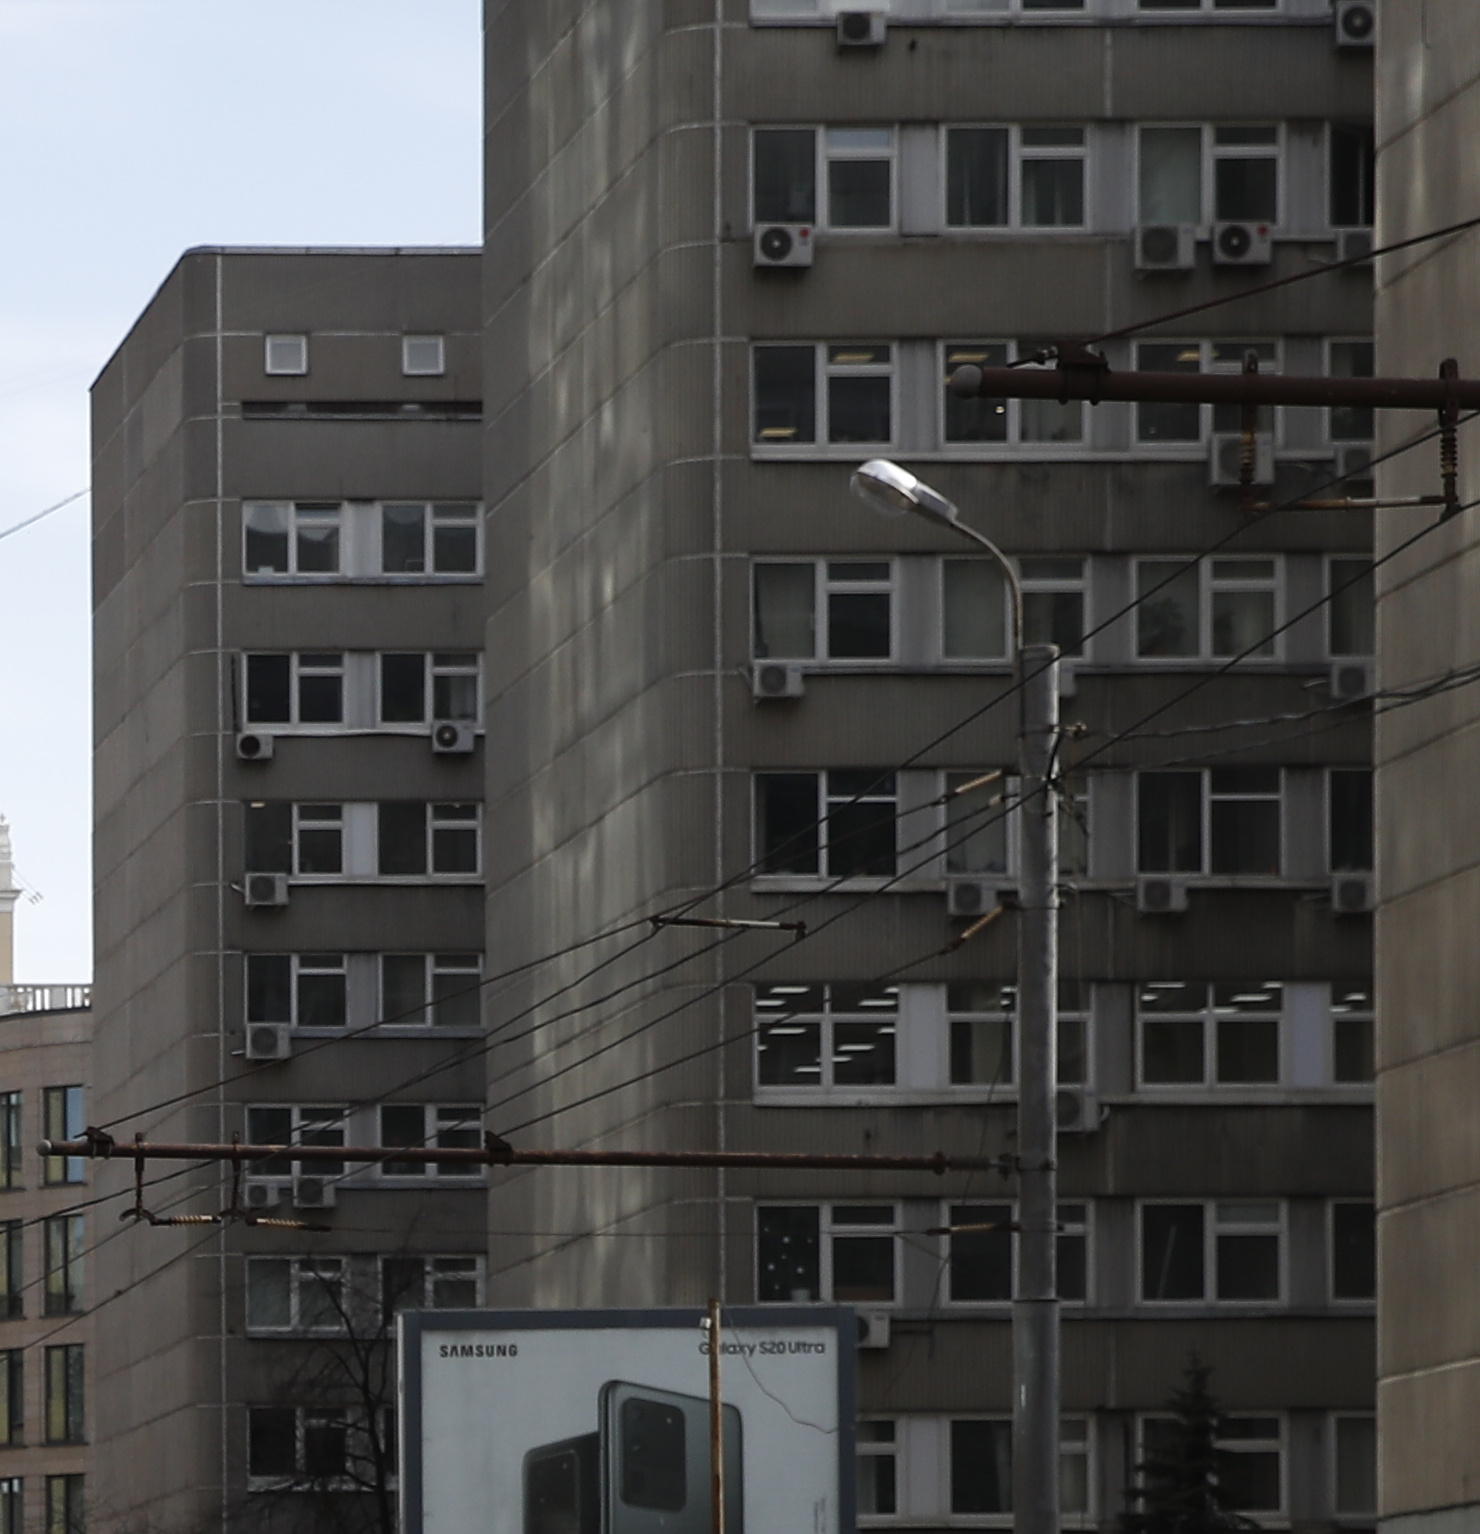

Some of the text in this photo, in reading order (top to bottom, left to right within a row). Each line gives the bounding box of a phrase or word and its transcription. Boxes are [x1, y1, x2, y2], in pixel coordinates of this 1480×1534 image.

[439, 1344, 518, 1358] SAMSUNG
[698, 1342, 756, 1357] Glaxy
[788, 1341, 825, 1354] Ultra
